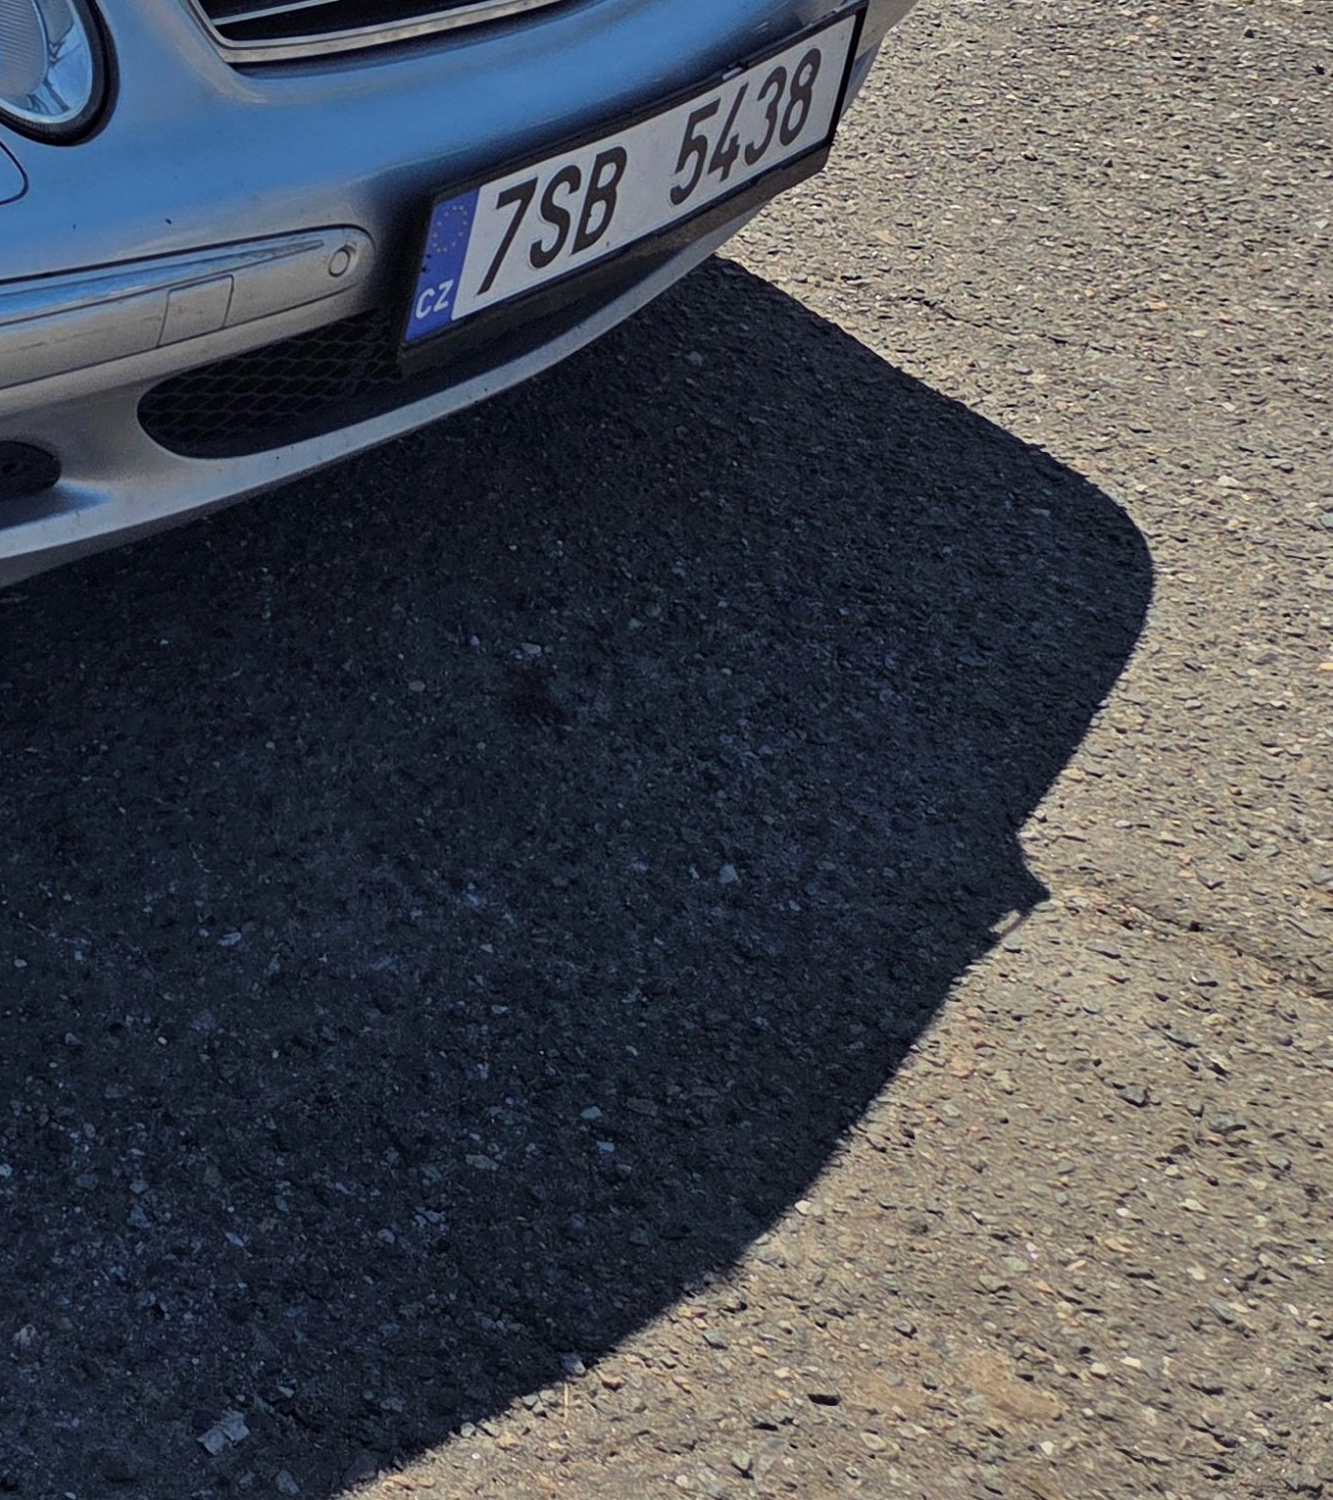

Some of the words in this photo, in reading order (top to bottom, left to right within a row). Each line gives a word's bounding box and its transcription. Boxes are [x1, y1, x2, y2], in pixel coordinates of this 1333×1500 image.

[476, 145, 628, 297] 7SB
[669, 47, 822, 207] 5438
[415, 279, 455, 320] CZ
